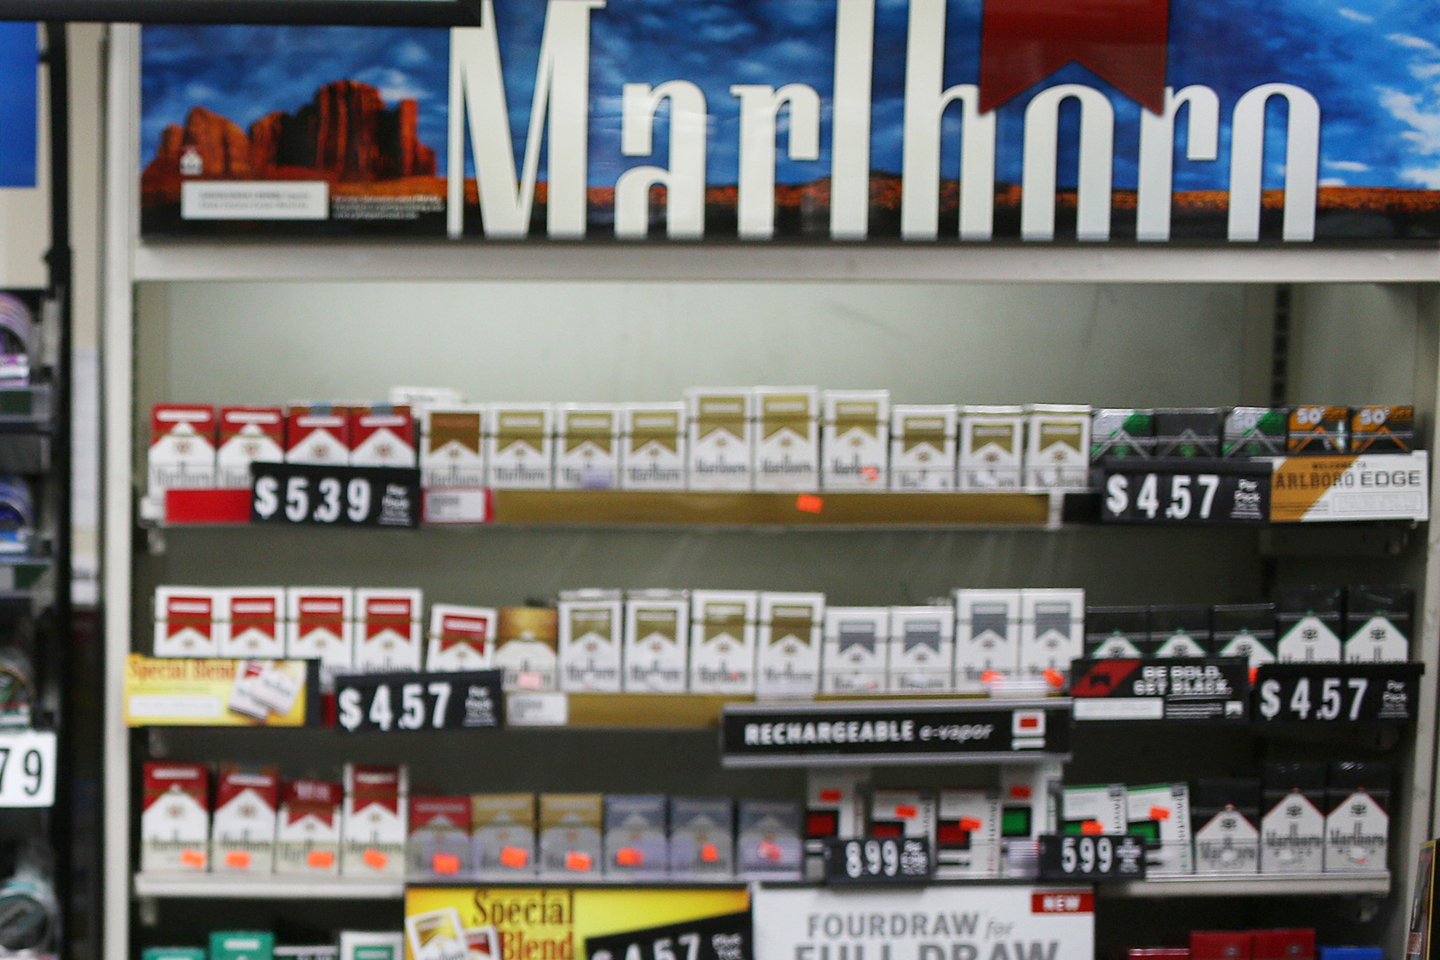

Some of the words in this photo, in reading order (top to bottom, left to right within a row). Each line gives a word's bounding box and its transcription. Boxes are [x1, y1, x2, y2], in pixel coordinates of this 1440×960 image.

[1273, 471, 1355, 490] ARLBORO
[1360, 470, 1421, 487] EDGE
[744, 719, 914, 746] RECHARGEABLE
[919, 721, 994, 746] e-vapor
[472, 888, 575, 928] Special
[1042, 896, 1082, 911] NEW
[807, 912, 981, 938] FOURDRAW
[985, 916, 1015, 940] for
